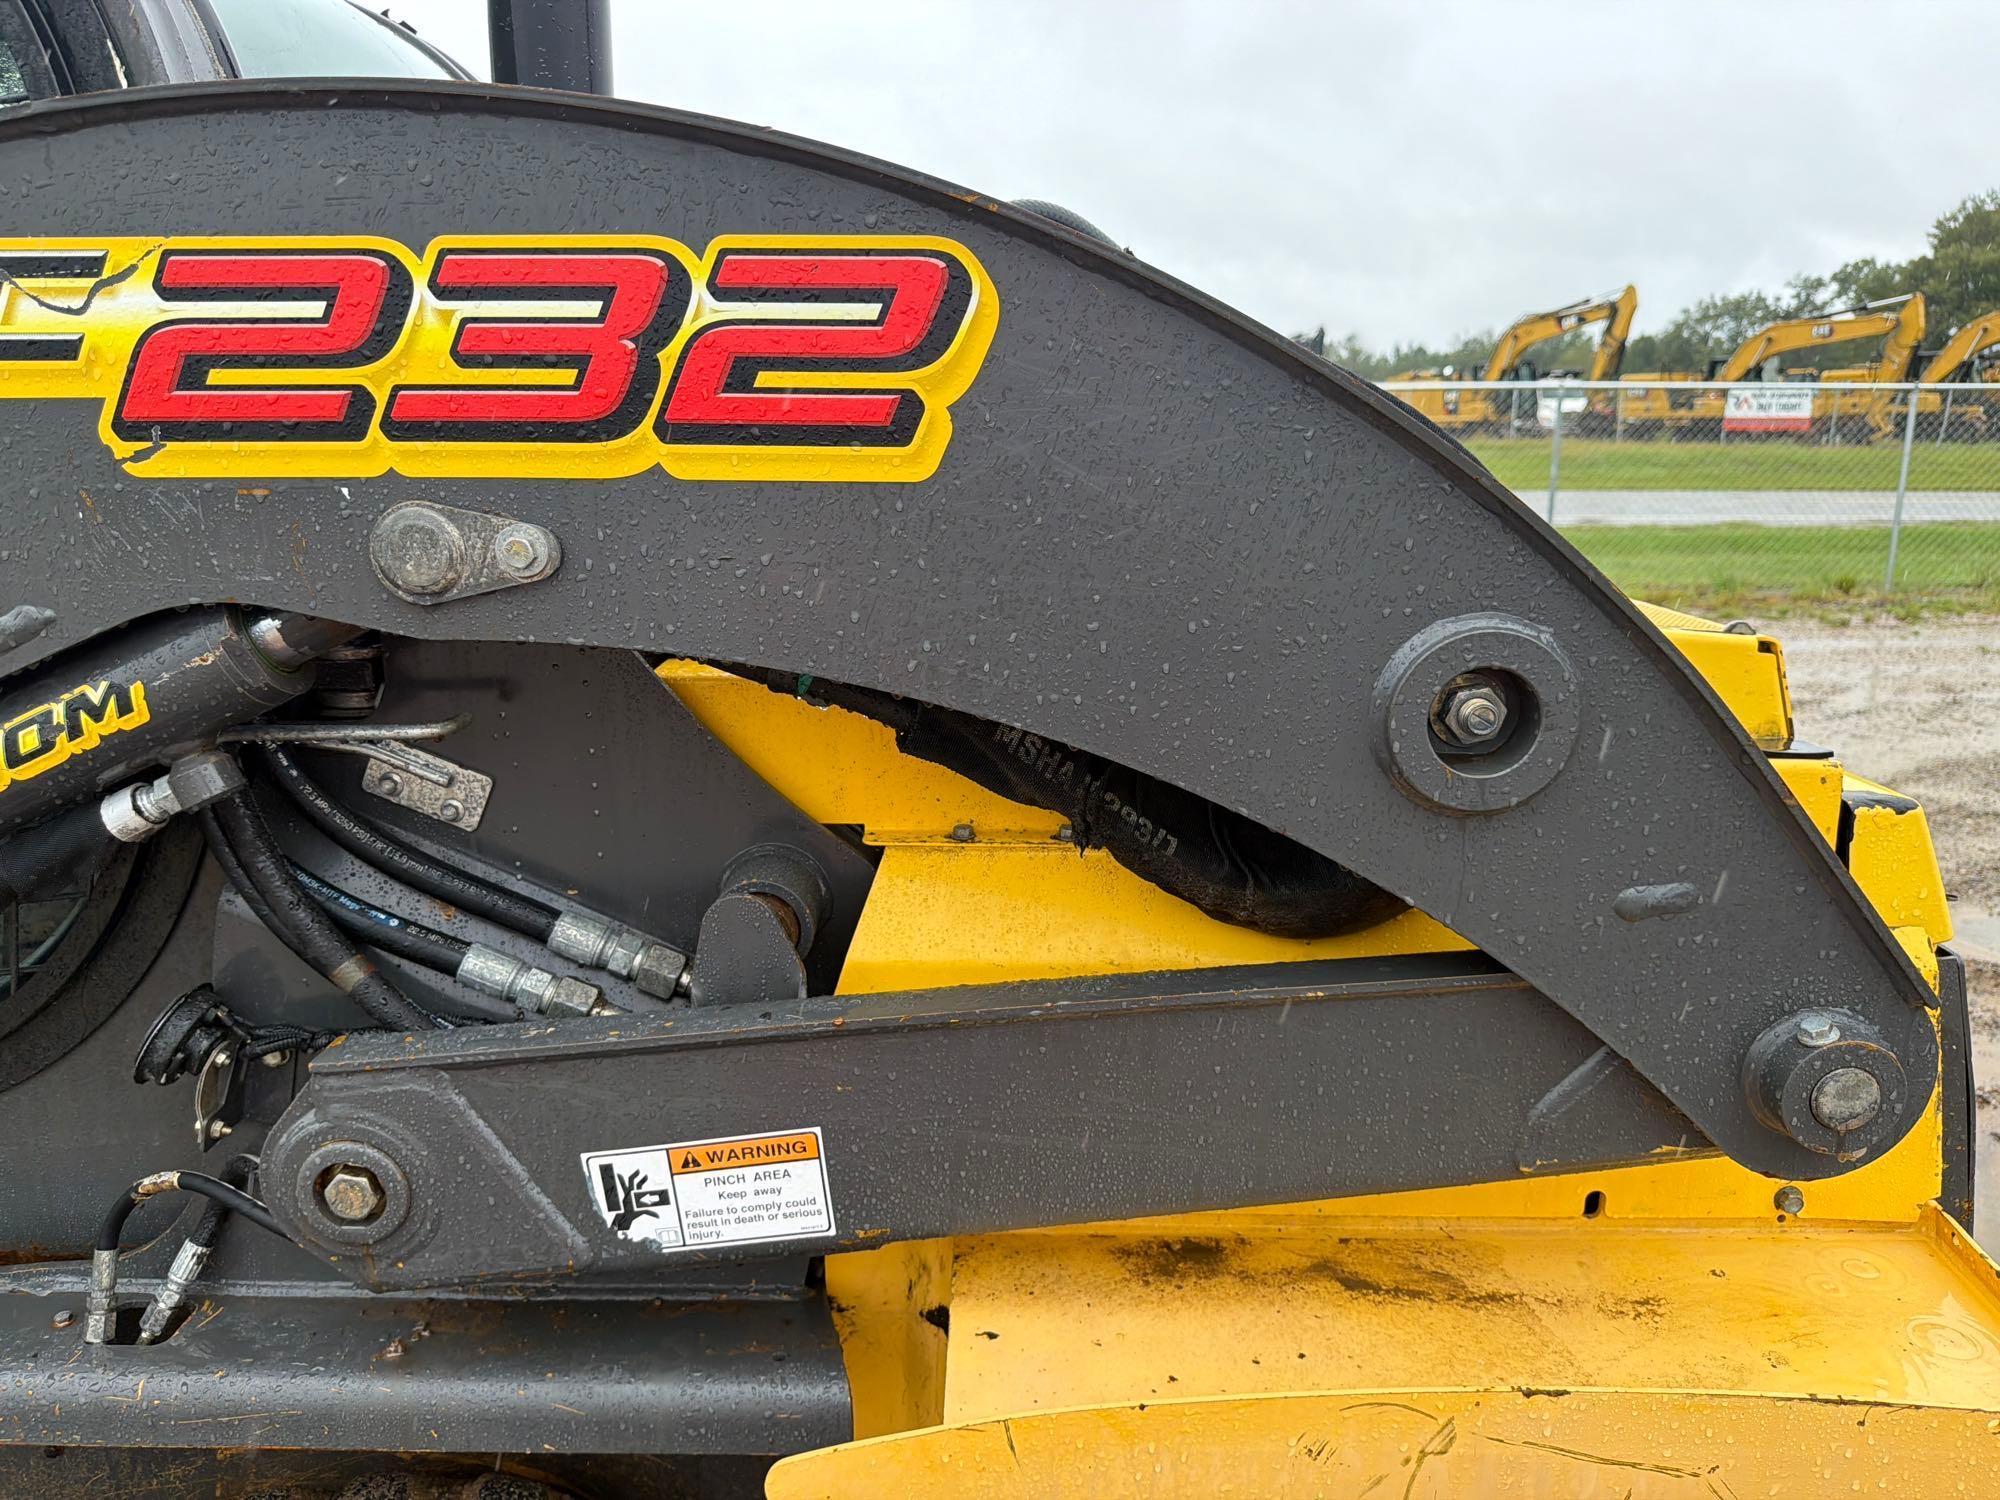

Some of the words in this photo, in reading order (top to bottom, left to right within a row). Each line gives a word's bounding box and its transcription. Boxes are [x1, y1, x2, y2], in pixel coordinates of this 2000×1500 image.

[996, 727, 1074, 792] MSHA
[706, 1141, 807, 1164] WARNING
[704, 1173, 746, 1187] PINCH
[754, 1169, 792, 1182] AREA
[718, 1190, 747, 1201] Keep
[754, 1186, 782, 1197] away
[685, 1208, 724, 1219] Failure
[727, 1206, 738, 1215] to
[741, 1201, 782, 1213] comply
[785, 1196, 817, 1208] could
[687, 1217, 719, 1230] result
[721, 1216, 731, 1227] in
[734, 1214, 765, 1225] death
[768, 1212, 778, 1221] or
[782, 1208, 823, 1219] serious
[689, 1229, 724, 1241] injury.
